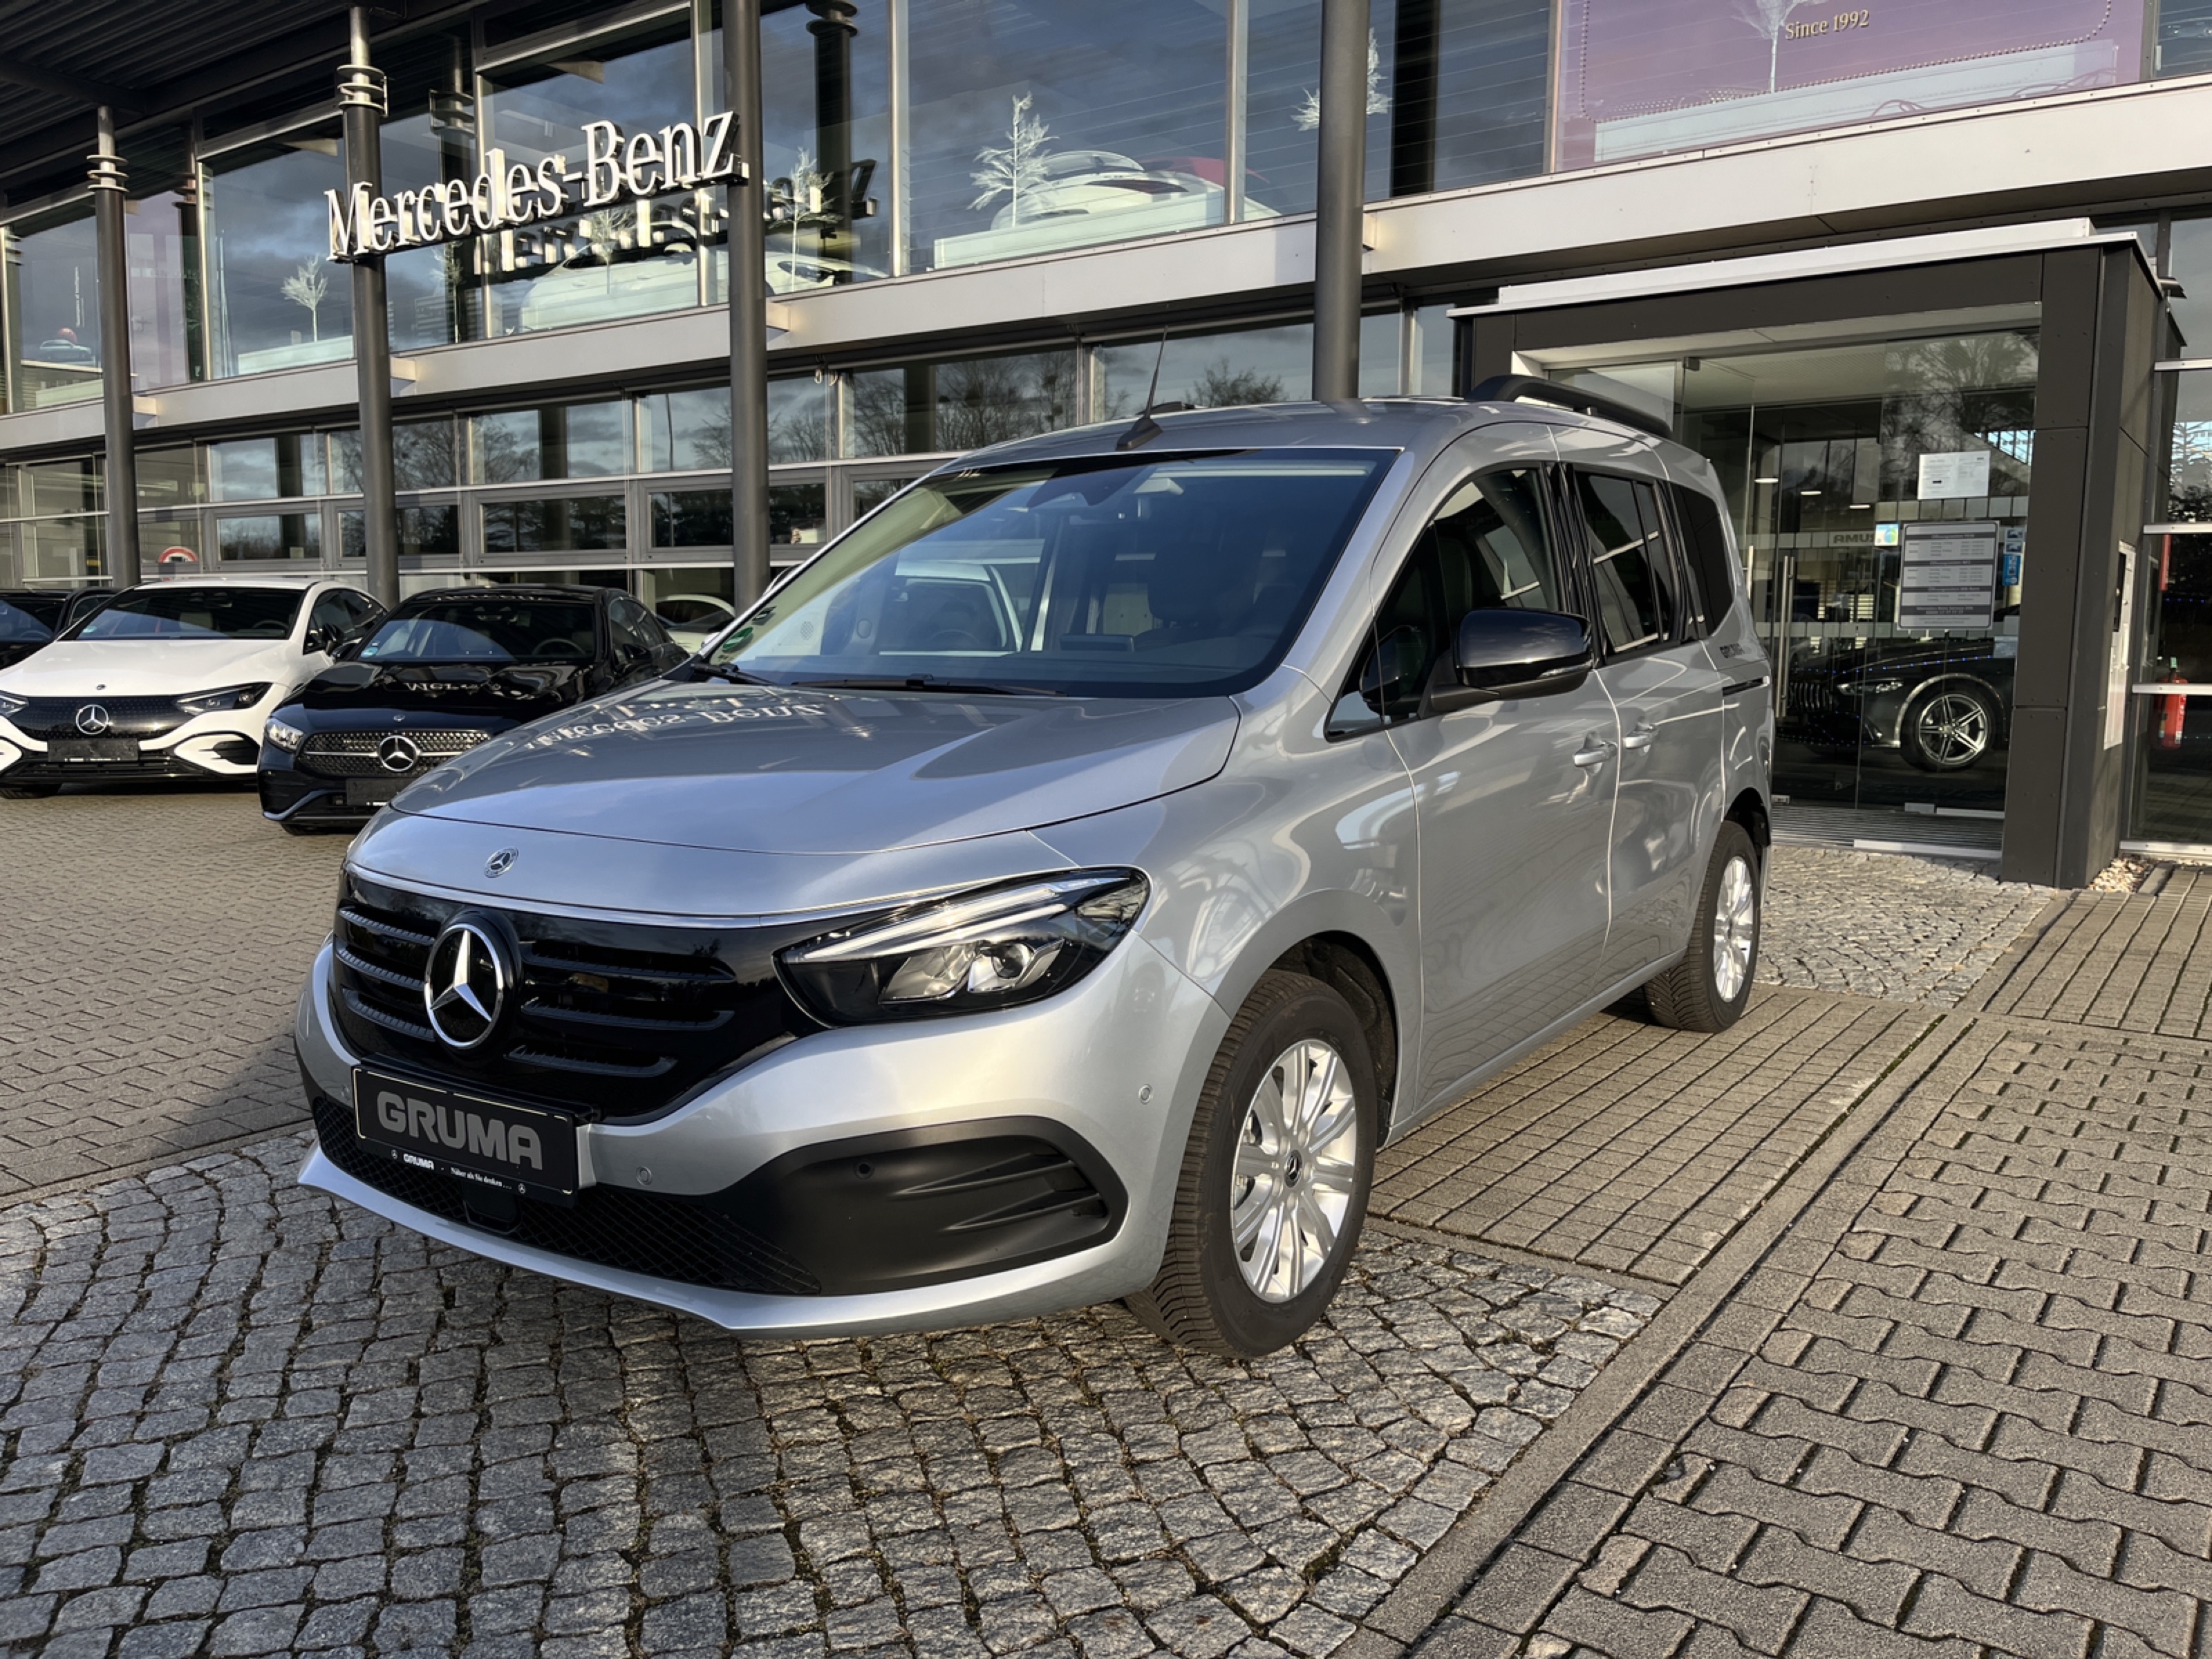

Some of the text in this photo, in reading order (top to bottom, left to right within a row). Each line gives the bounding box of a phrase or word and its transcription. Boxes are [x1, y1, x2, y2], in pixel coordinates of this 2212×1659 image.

[1785, 9, 1870, 39] Since 1992
[324, 111, 743, 262] Mercedes-Benz
[377, 1091, 543, 1170] GRUMA
[403, 1154, 435, 1170] GRUMA
